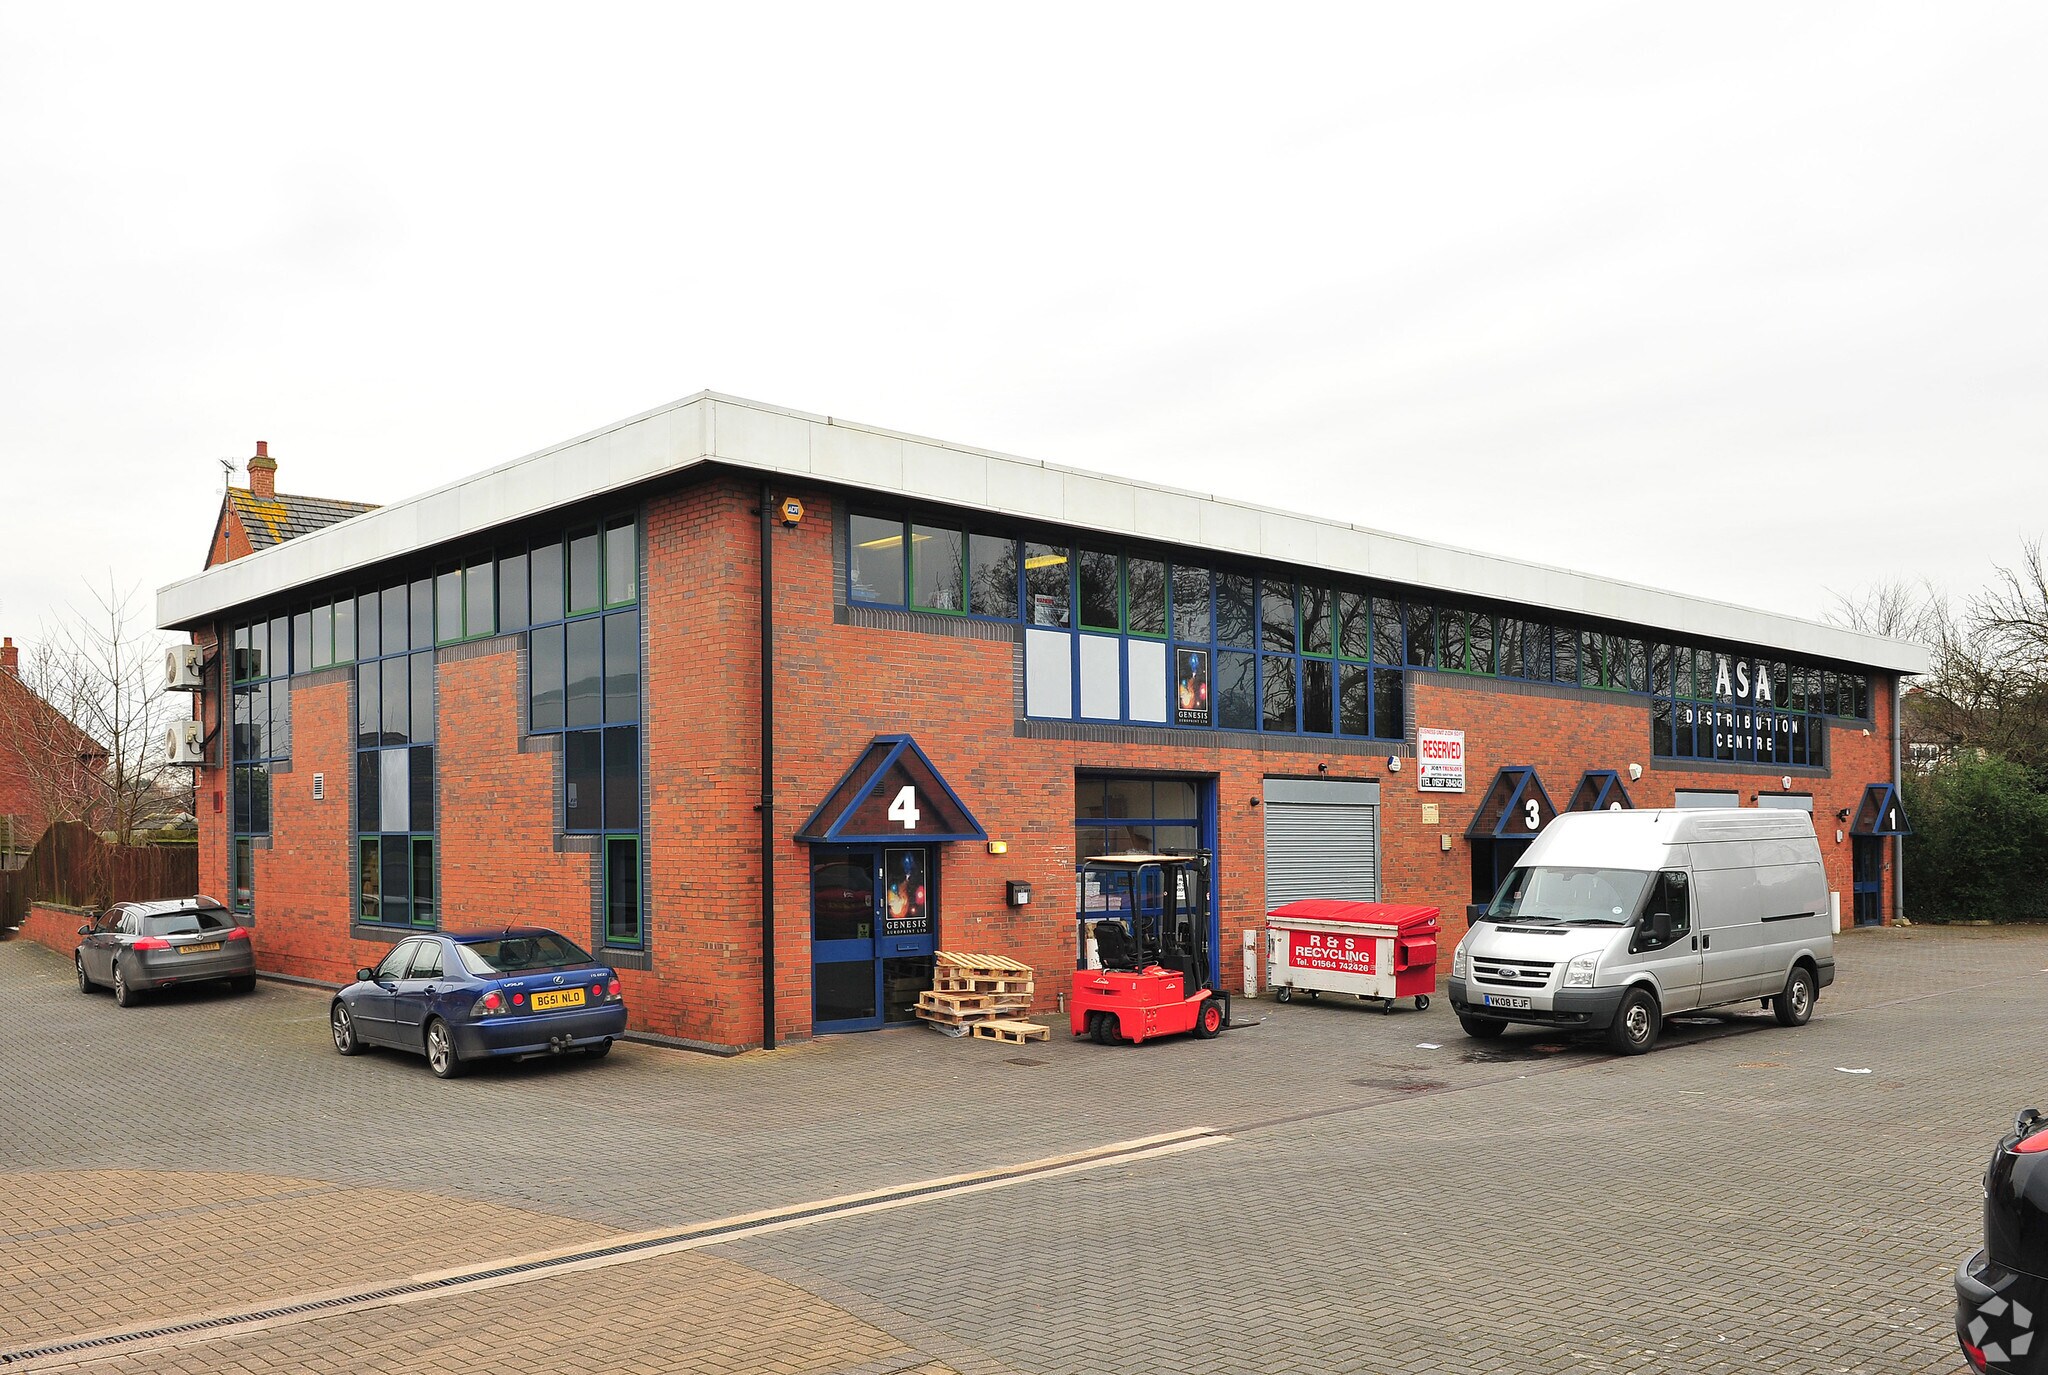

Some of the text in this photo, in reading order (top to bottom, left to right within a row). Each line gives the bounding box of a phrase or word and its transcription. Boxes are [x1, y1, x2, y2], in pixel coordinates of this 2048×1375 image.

[788, 505, 798, 513] ADT
[1715, 659, 1772, 701] ASA
[1178, 711, 1208, 719] GENESIS
[1686, 709, 1798, 734] DISTRIBUTION
[1423, 740, 1461, 759] RESERVED
[1716, 733, 1773, 751] CENTRE
[888, 786, 920, 829] 4
[1525, 798, 1540, 830] 3
[1889, 808, 1896, 830] 1
[886, 920, 927, 930] GENESIS
[1310, 935, 1355, 950] R & S
[1295, 946, 1370, 962] RECYCLING
[1296, 957, 1310, 966] Tel.
[1312, 959, 1337, 968] 01564
[537, 992, 580, 1006] BG51 NLO
[1490, 997, 1529, 1008] VK08 EJF
